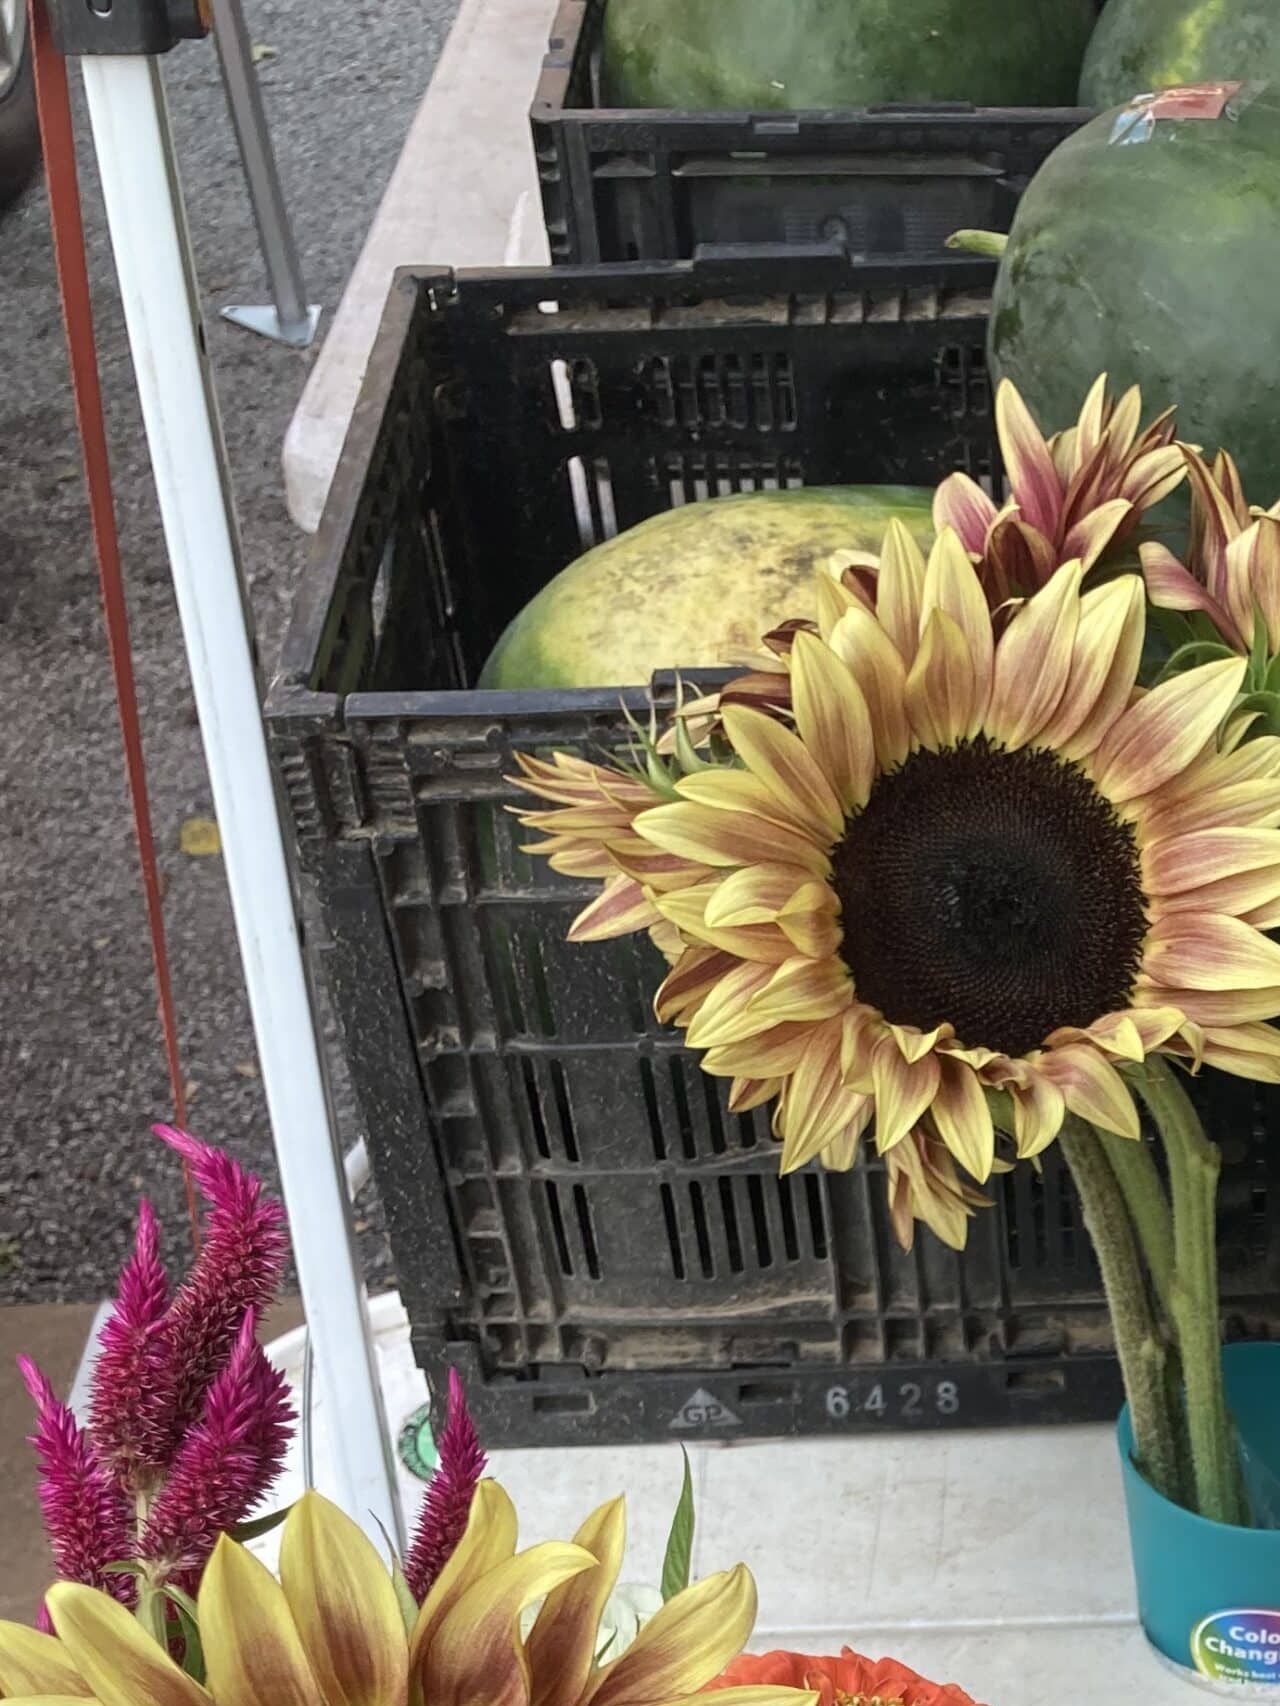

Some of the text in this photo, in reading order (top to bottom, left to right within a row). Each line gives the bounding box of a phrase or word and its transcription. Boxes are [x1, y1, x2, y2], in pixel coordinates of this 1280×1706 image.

[825, 1381, 960, 1419] 6428
[1214, 1663, 1250, 1678] Works
[1252, 1669, 1276, 1679] best
